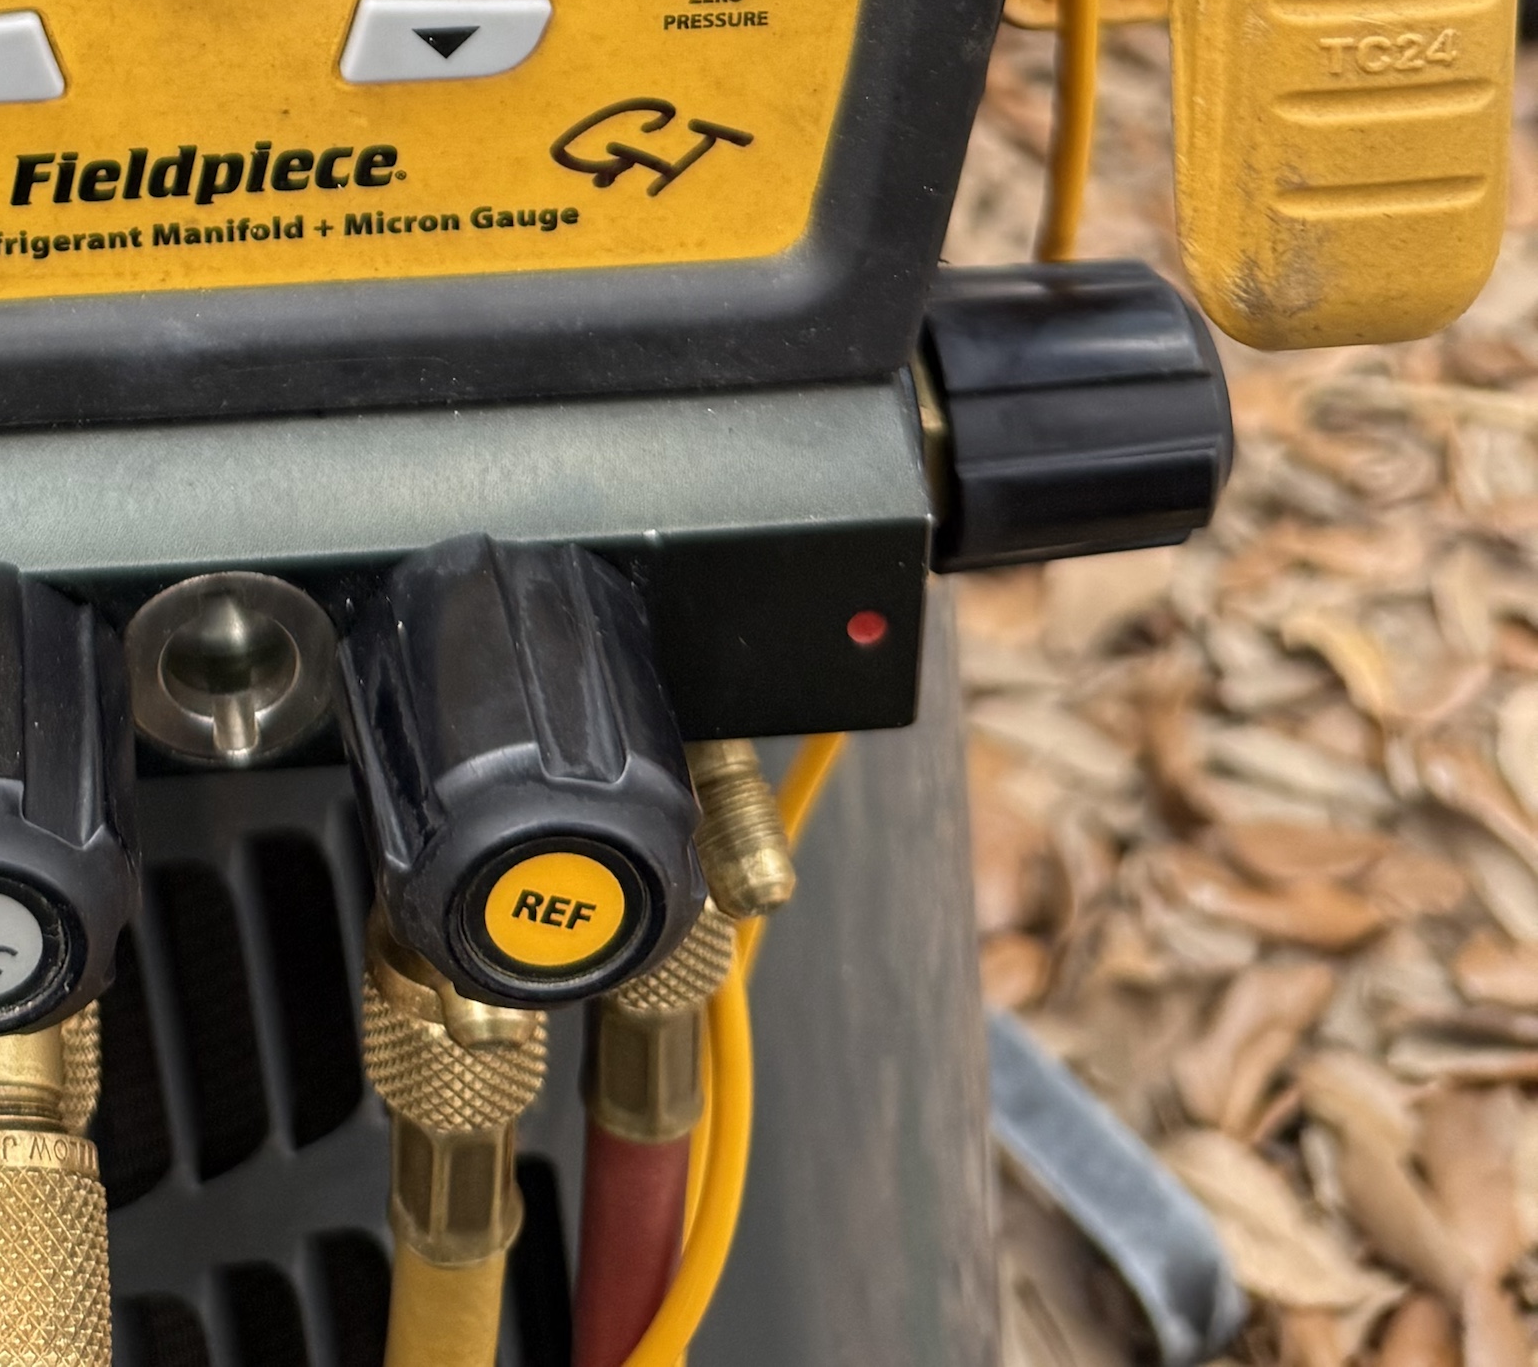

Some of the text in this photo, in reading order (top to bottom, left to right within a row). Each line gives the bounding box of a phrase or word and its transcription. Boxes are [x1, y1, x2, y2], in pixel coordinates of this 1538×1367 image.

[663, 10, 769, 31] PRESSURE
[1319, 28, 1460, 74] TC24
[549, 96, 754, 197] GT
[152, 214, 304, 246] Manifold
[313, 218, 334, 238] +
[343, 209, 460, 236] Micron
[469, 203, 580, 232] Gauge
[511, 888, 597, 930] REF
